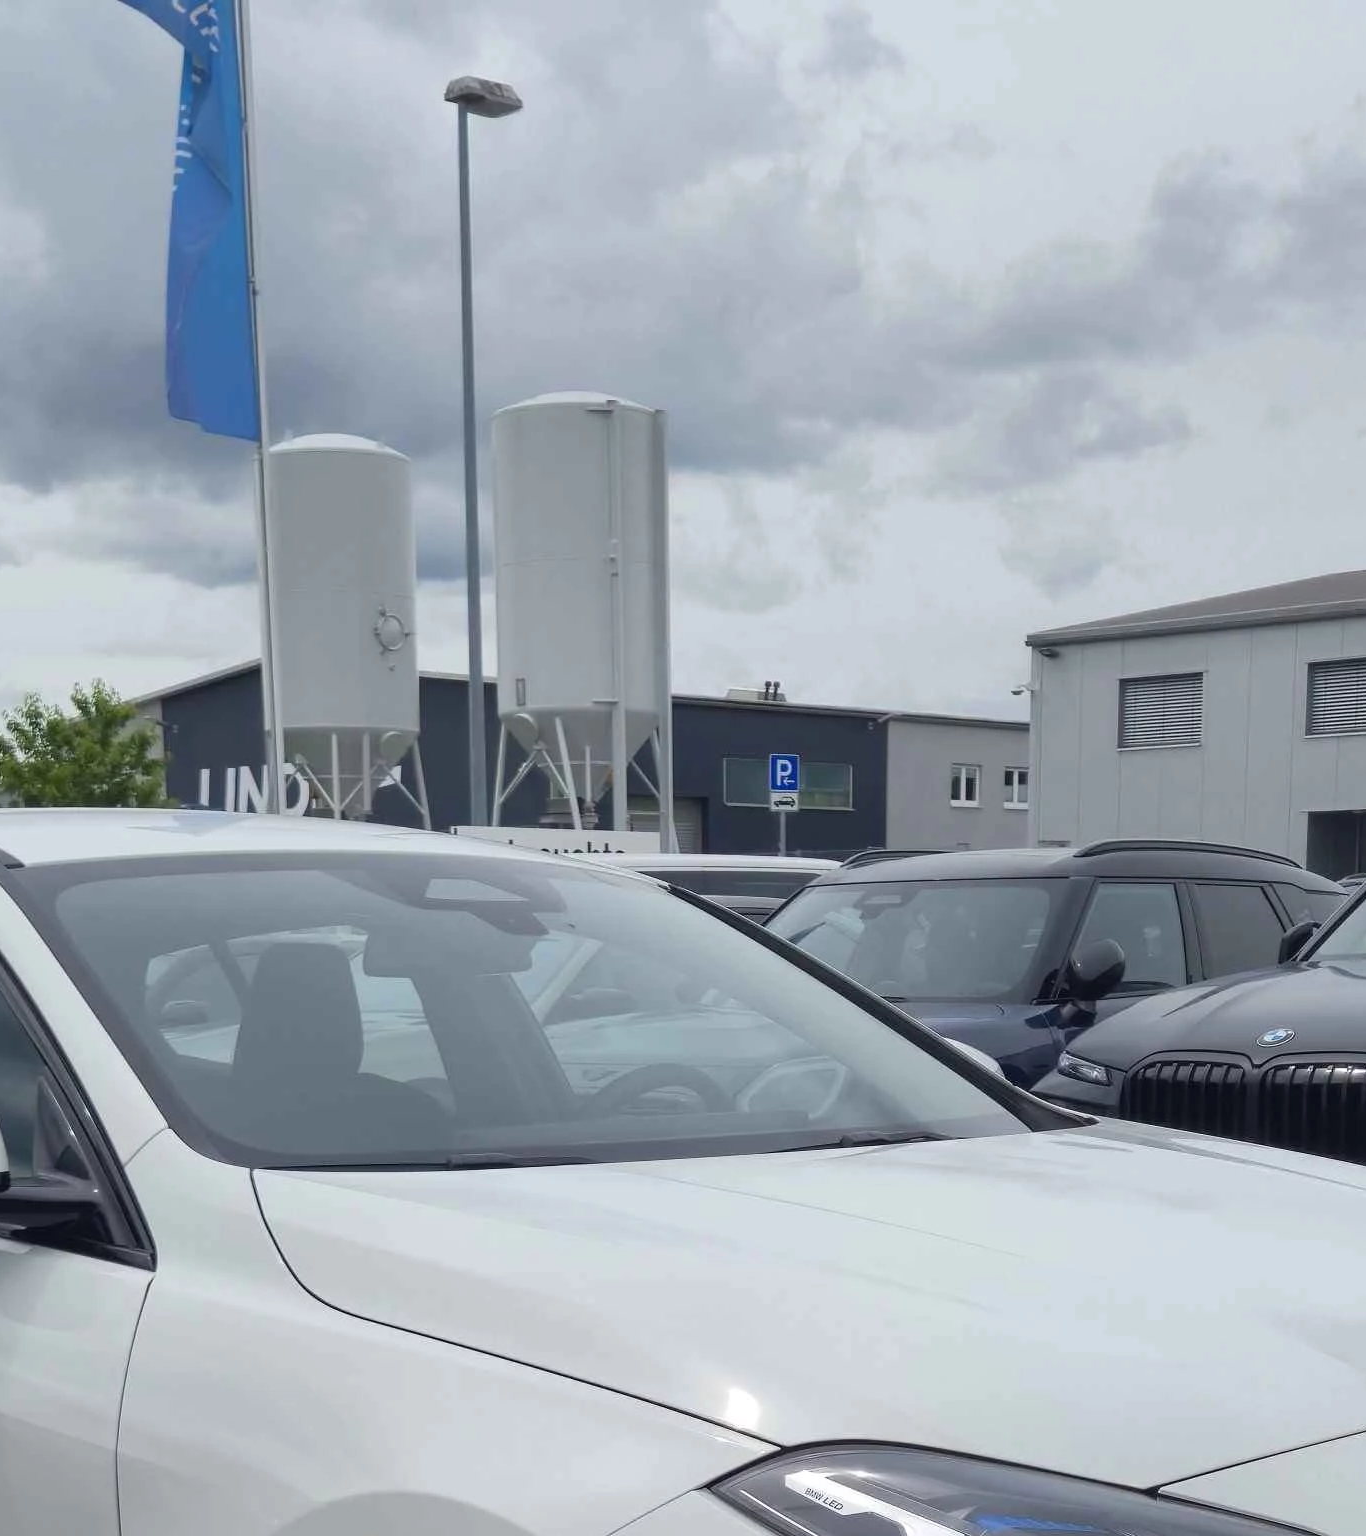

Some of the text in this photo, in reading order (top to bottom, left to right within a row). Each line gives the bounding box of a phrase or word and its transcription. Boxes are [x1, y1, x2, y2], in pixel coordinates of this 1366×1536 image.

[776, 759, 792, 786] P
[804, 1487, 844, 1511] BMW LED
